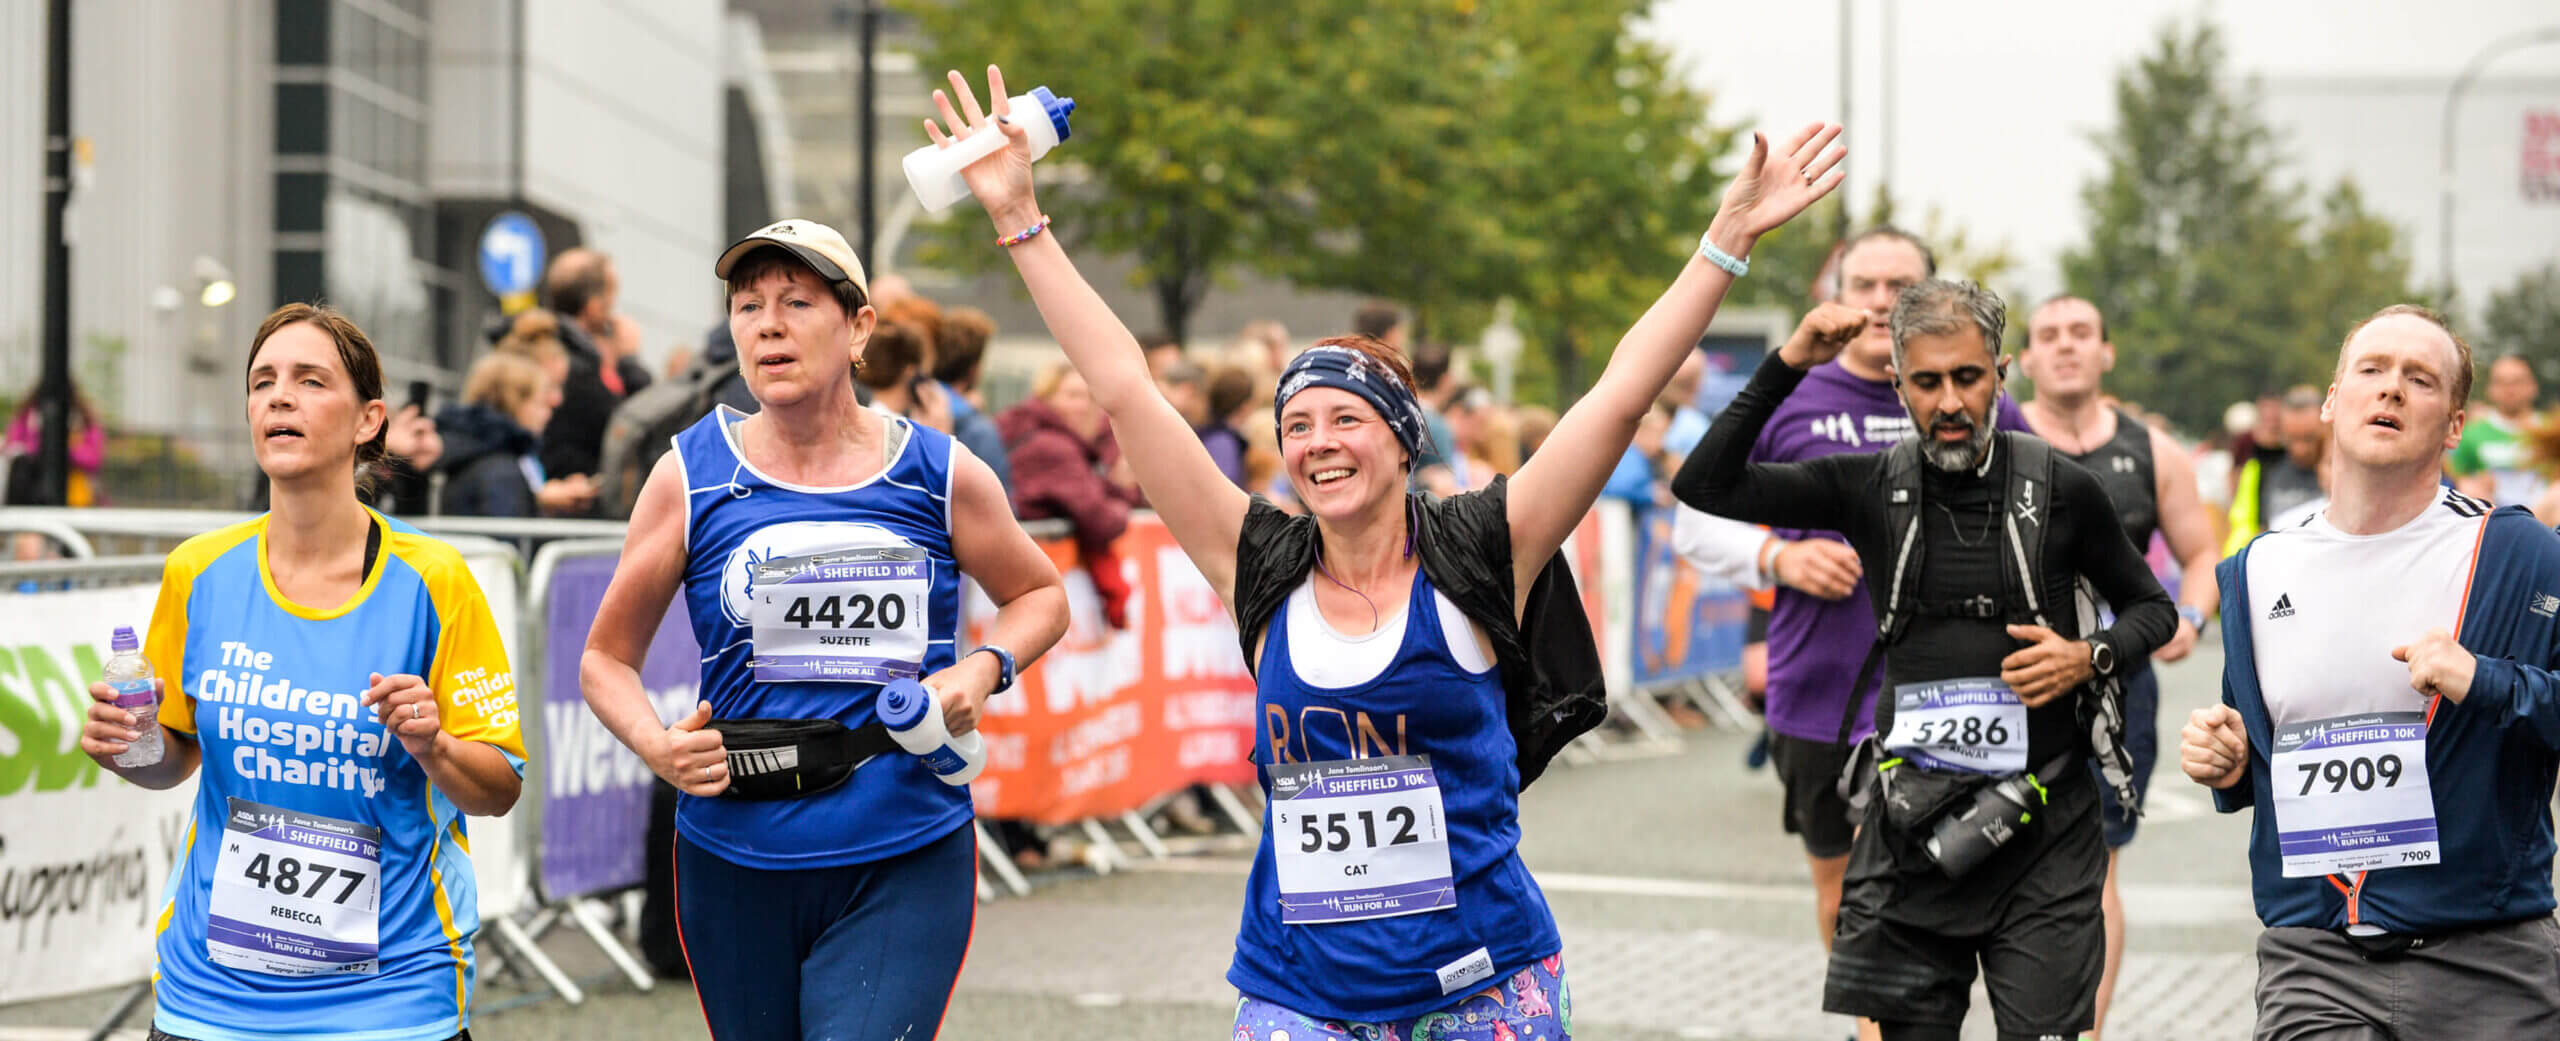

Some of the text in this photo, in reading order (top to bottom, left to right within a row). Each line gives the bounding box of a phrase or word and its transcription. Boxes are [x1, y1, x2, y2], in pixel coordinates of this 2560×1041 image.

[824, 565, 917, 579] SHEFFIELD 10K
[766, 596, 772, 605] L
[784, 593, 906, 630] 4420
[2268, 608, 2295, 620] adidas
[820, 636, 871, 646] SUZETTE
[220, 641, 273, 671] The
[454, 667, 486, 685] The
[843, 667, 860, 675] FOR
[861, 668, 876, 677] ALL
[1944, 692, 1998, 705] SHEFFIELD
[219, 707, 391, 758] Hospital
[1912, 716, 2008, 745] 5286
[2330, 727, 2416, 744] SHEFFIELD 10K
[233, 746, 378, 800] Charity
[1328, 763, 1388, 775] Jane Tomlinson's
[2298, 754, 2402, 796] 7909
[1329, 773, 1427, 793] SHEFFIELD 10K
[293, 817, 311, 826] Jane
[1281, 813, 1288, 824] S
[1300, 806, 1418, 853] 5512
[290, 830, 358, 852] SHEFFIELD
[2341, 834, 2391, 847] RUN FOR ALL
[230, 843, 240, 854] M
[2401, 850, 2431, 862] 7909
[1344, 864, 1369, 876] CAT
[244, 853, 367, 904] 4877
[1344, 899, 1400, 912] RUN FOR ALL
[270, 906, 322, 926] REBECCA
[275, 943, 328, 958] RUN FOR ALL
